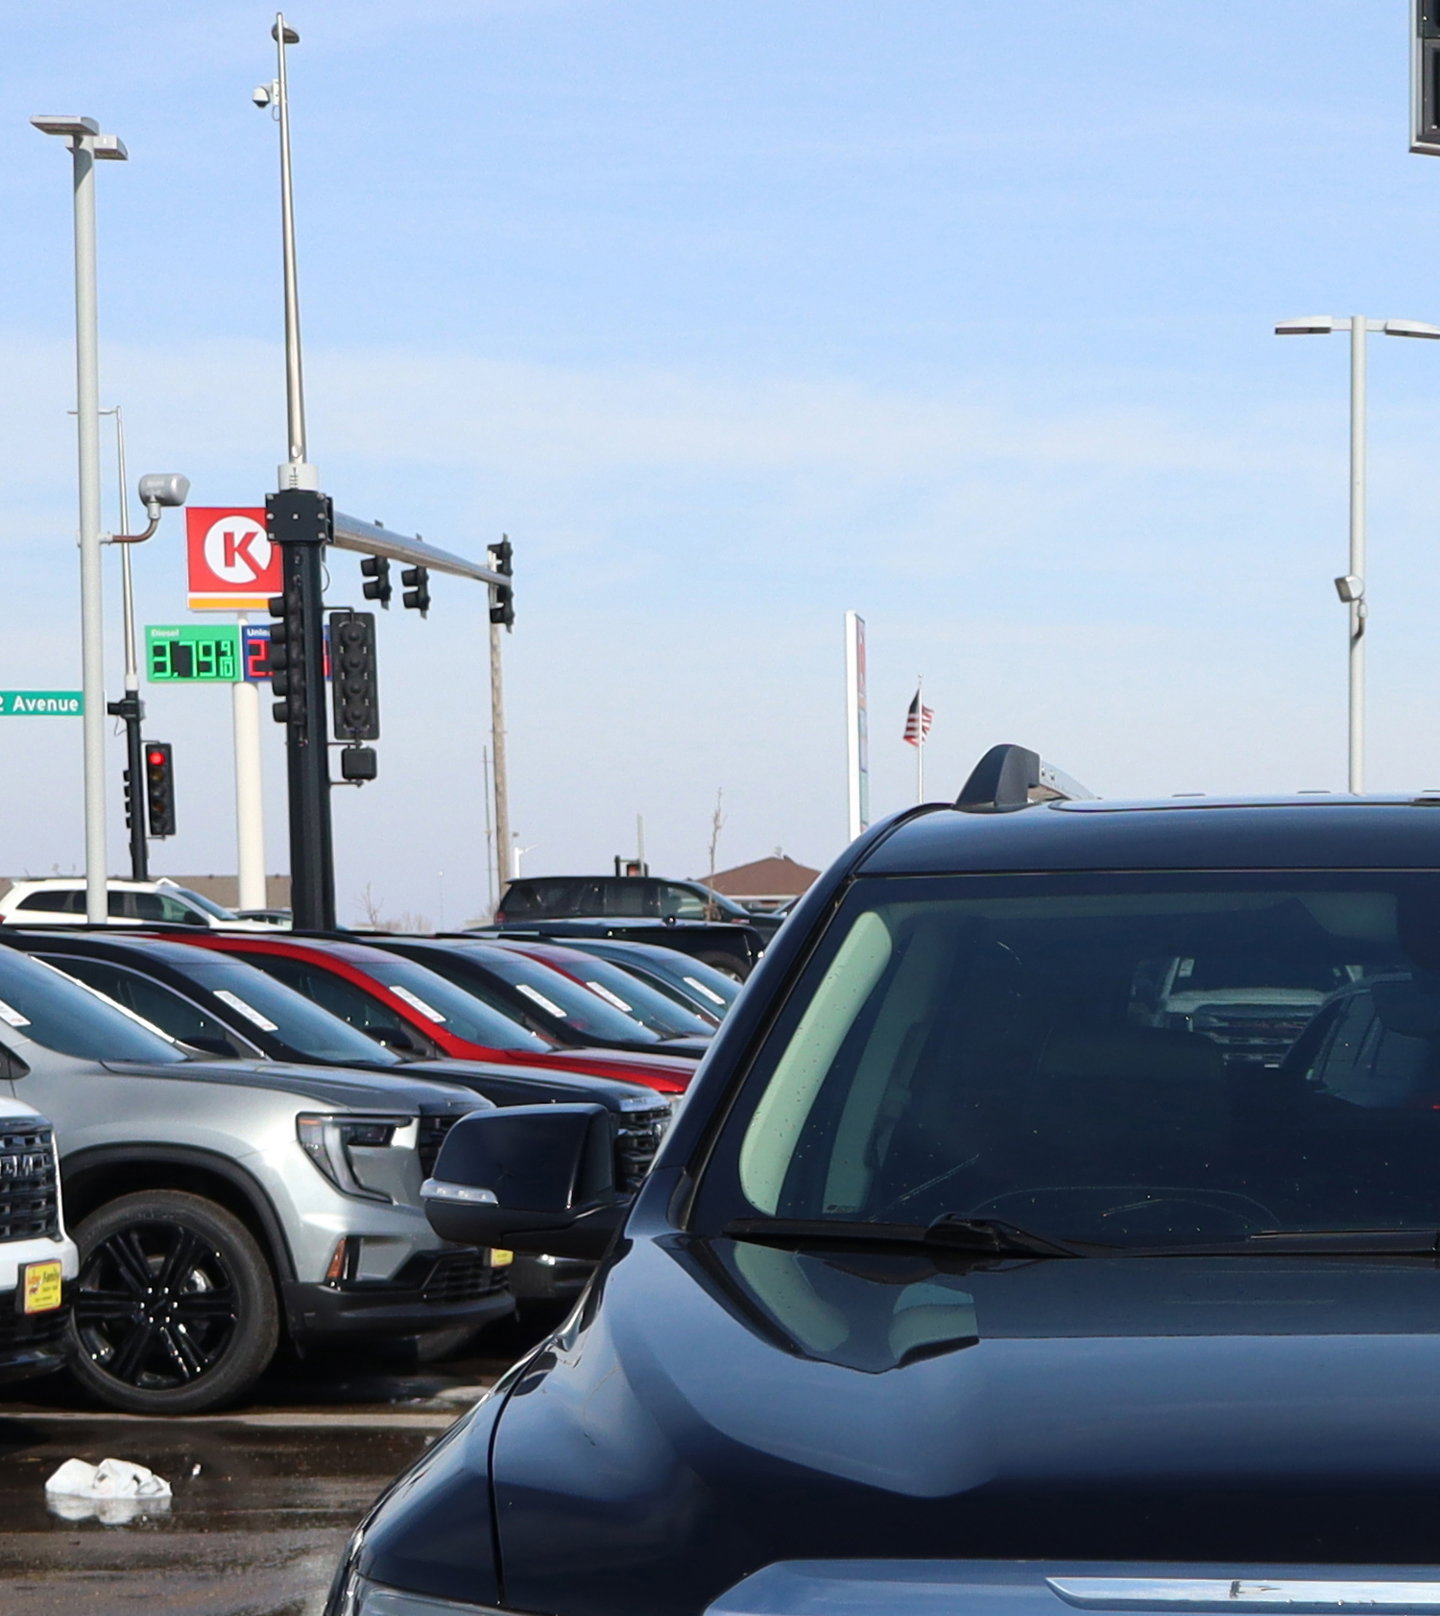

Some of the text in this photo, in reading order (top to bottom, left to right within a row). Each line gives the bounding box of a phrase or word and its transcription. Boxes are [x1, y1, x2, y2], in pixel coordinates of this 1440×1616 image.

[222, 531, 264, 580] K
[150, 628, 180, 637] Diesel
[12, 695, 79, 712] Avenue
